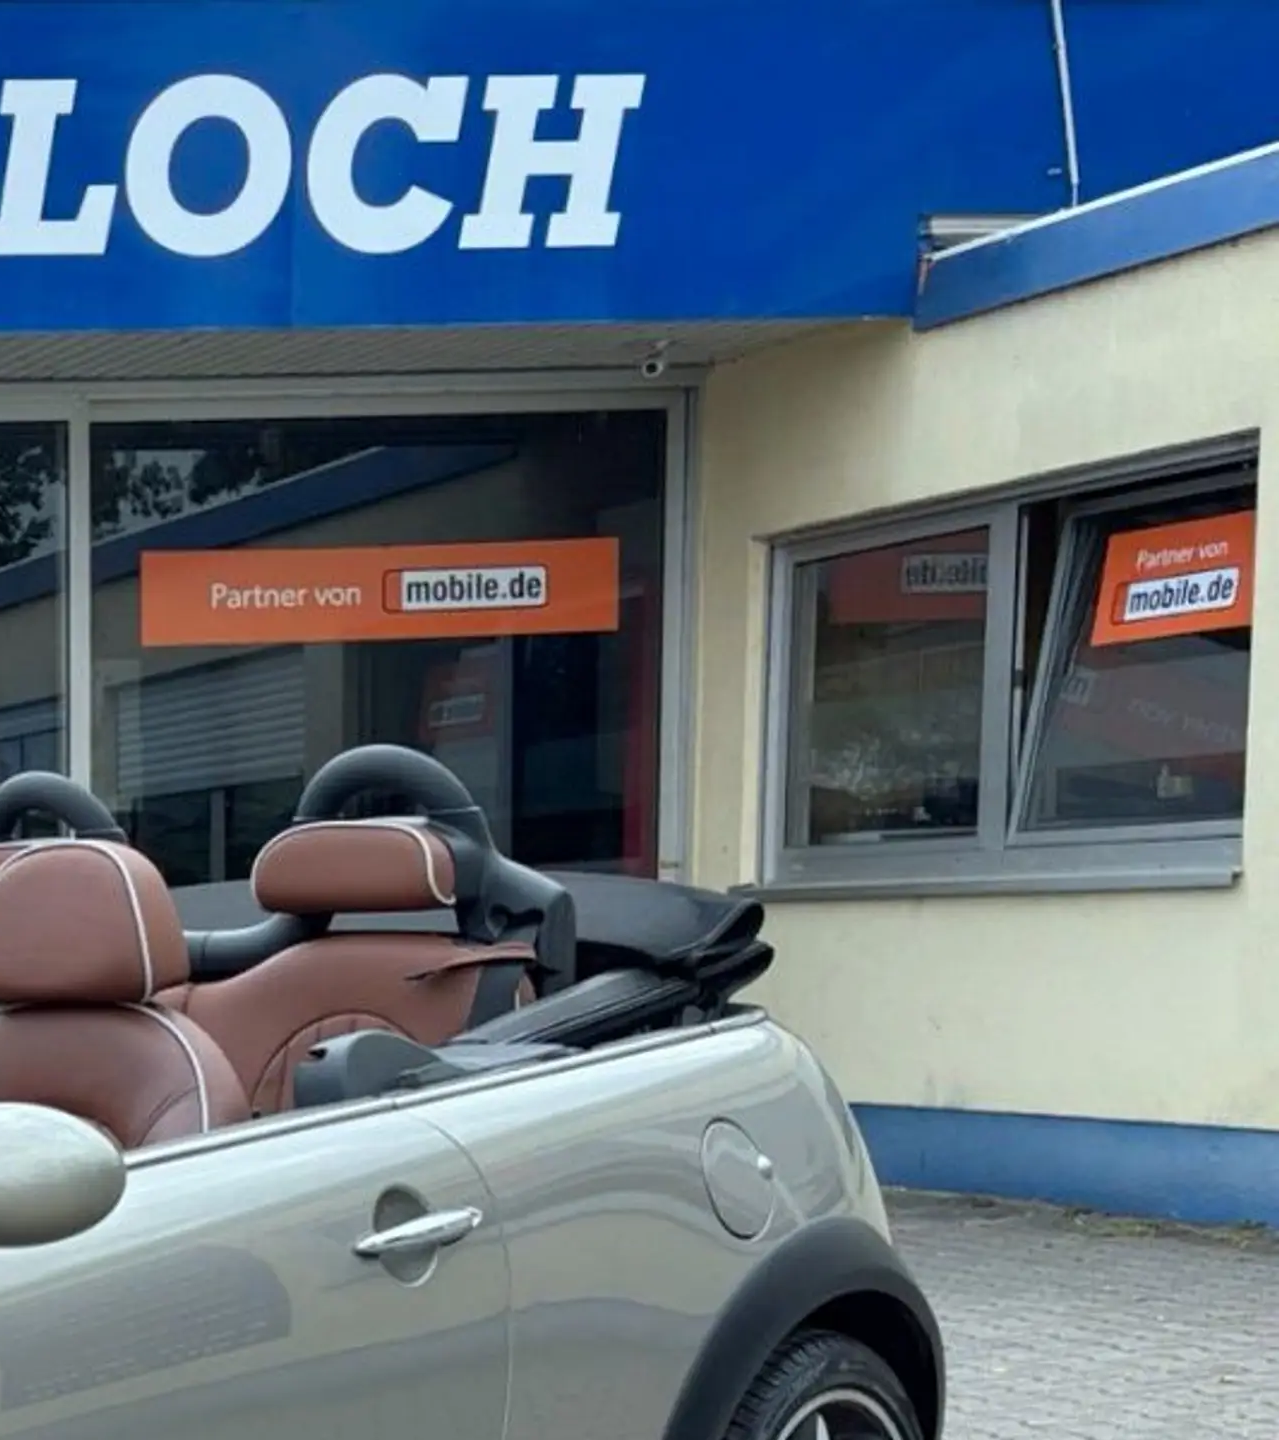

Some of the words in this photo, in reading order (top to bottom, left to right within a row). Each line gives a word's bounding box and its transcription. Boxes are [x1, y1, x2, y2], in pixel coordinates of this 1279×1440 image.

[1137, 548, 1194, 571] Partner
[1198, 541, 1229, 560] von
[210, 582, 308, 610] Partner
[314, 586, 362, 607] von
[406, 570, 544, 603] mobile.de
[1129, 574, 1234, 614] mobile.de
